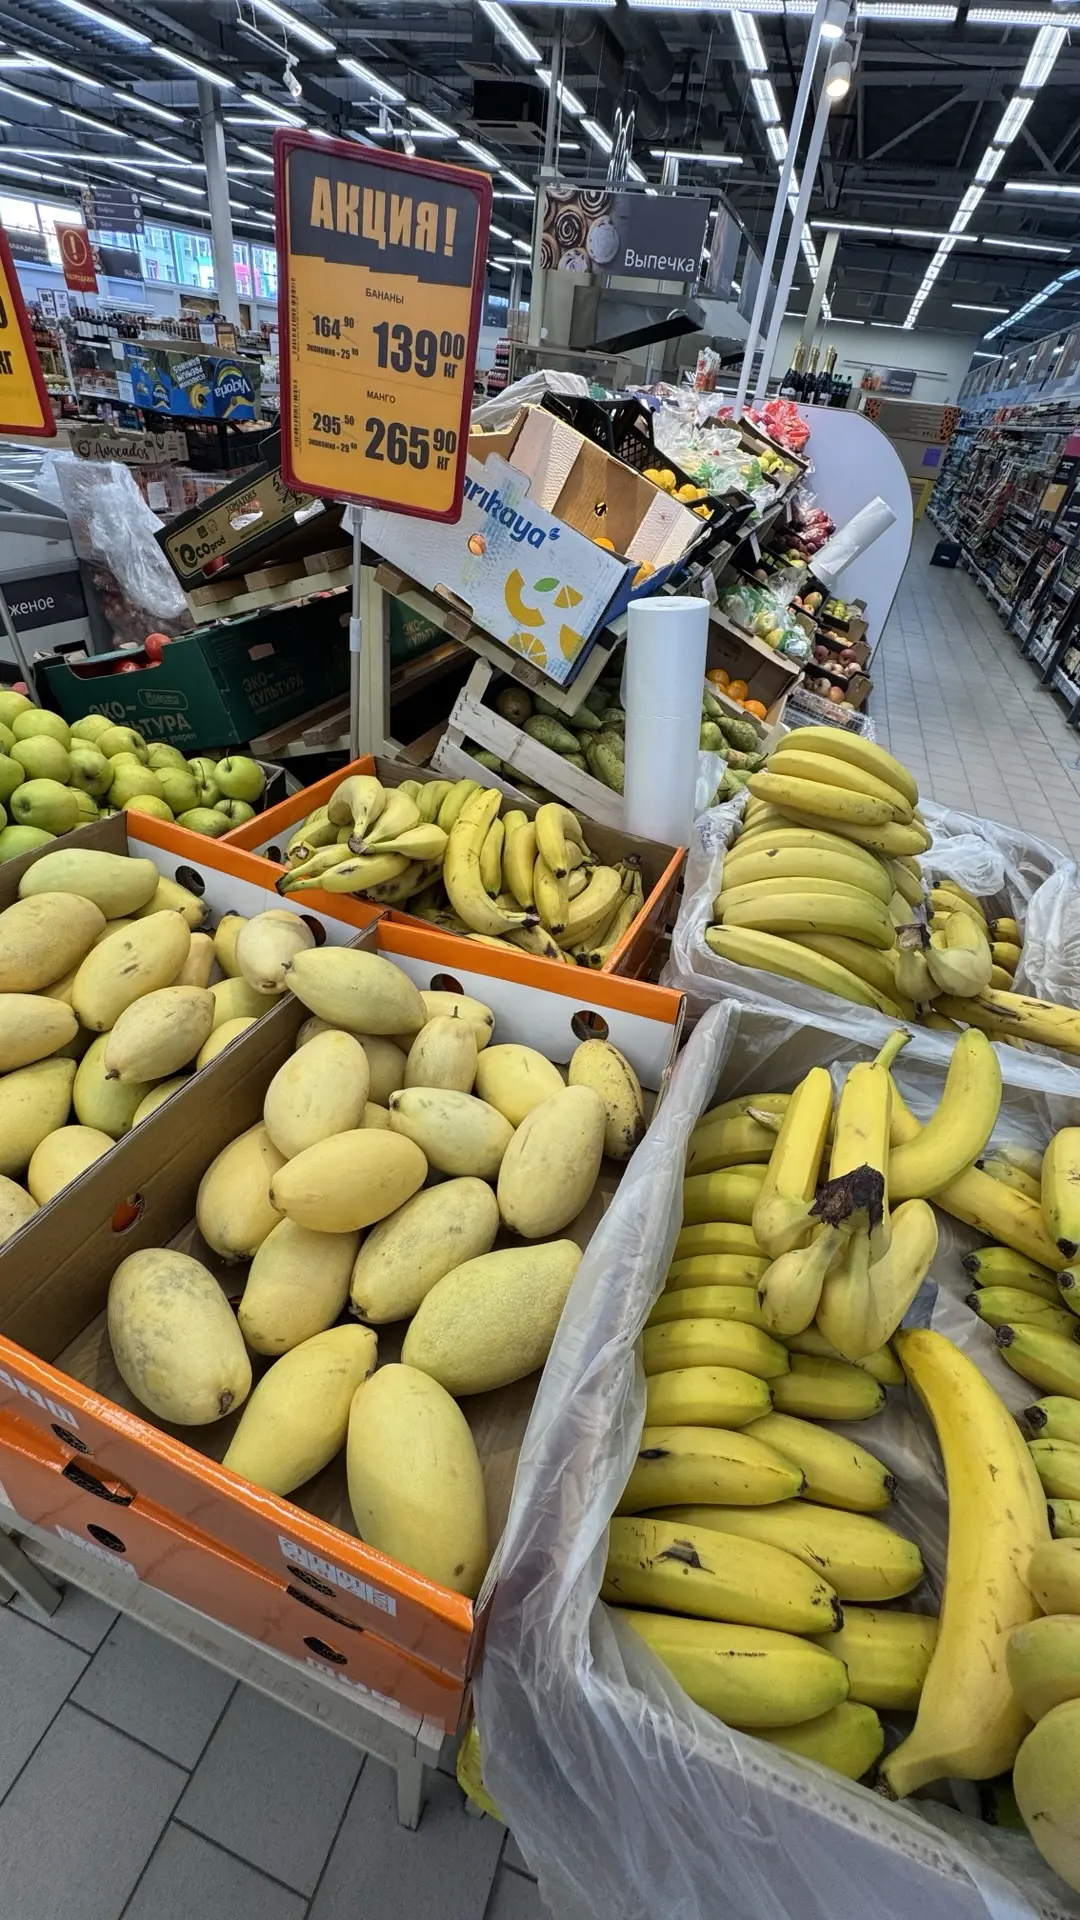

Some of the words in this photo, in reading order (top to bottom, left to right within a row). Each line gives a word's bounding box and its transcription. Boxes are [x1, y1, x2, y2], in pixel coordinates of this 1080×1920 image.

[310, 175, 457, 257] АКЦИЯ!
[623, 249, 695, 273] Выпечка
[365, 287, 404, 304] БАНАНЫ
[312, 315, 342, 340] 164
[373, 321, 438, 378] 139
[440, 331, 466, 361] 00
[341, 348, 351, 360] 25
[214, 378, 251, 398] Victoria
[366, 390, 396, 404] МАНГО
[94, 442, 150, 461] Avocados
[312, 412, 342, 435] 295
[365, 417, 430, 470] 265
[432, 428, 457, 454] 90
[225, 489, 257, 514] TOMATOES
[8, 596, 55, 617] женое
